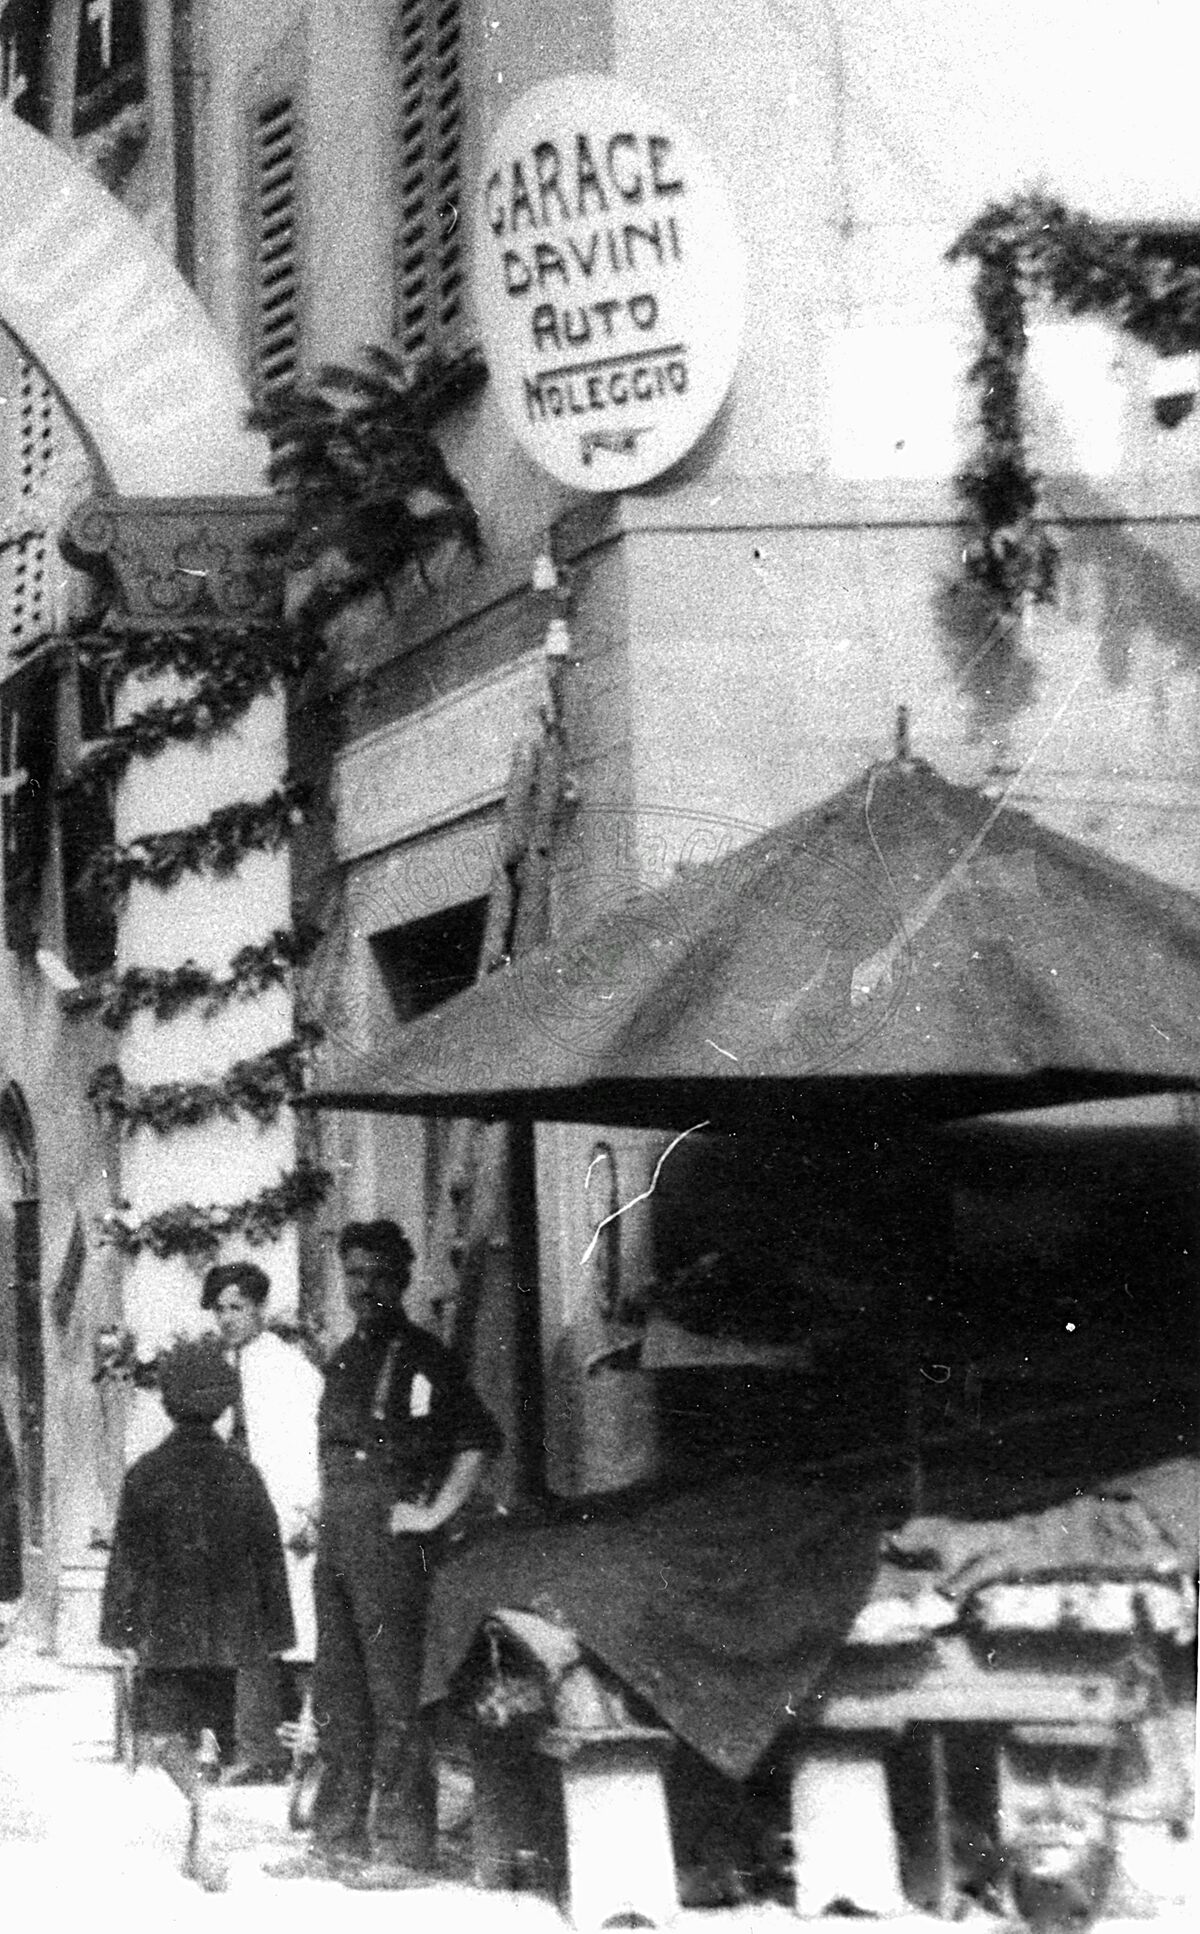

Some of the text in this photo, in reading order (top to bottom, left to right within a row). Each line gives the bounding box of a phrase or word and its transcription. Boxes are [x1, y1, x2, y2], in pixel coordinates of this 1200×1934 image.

[485, 131, 684, 237] GARAGE
[502, 217, 682, 296] DAVINI
[531, 294, 659, 352] AUTO
[523, 360, 689, 422] NOLEGGIO
